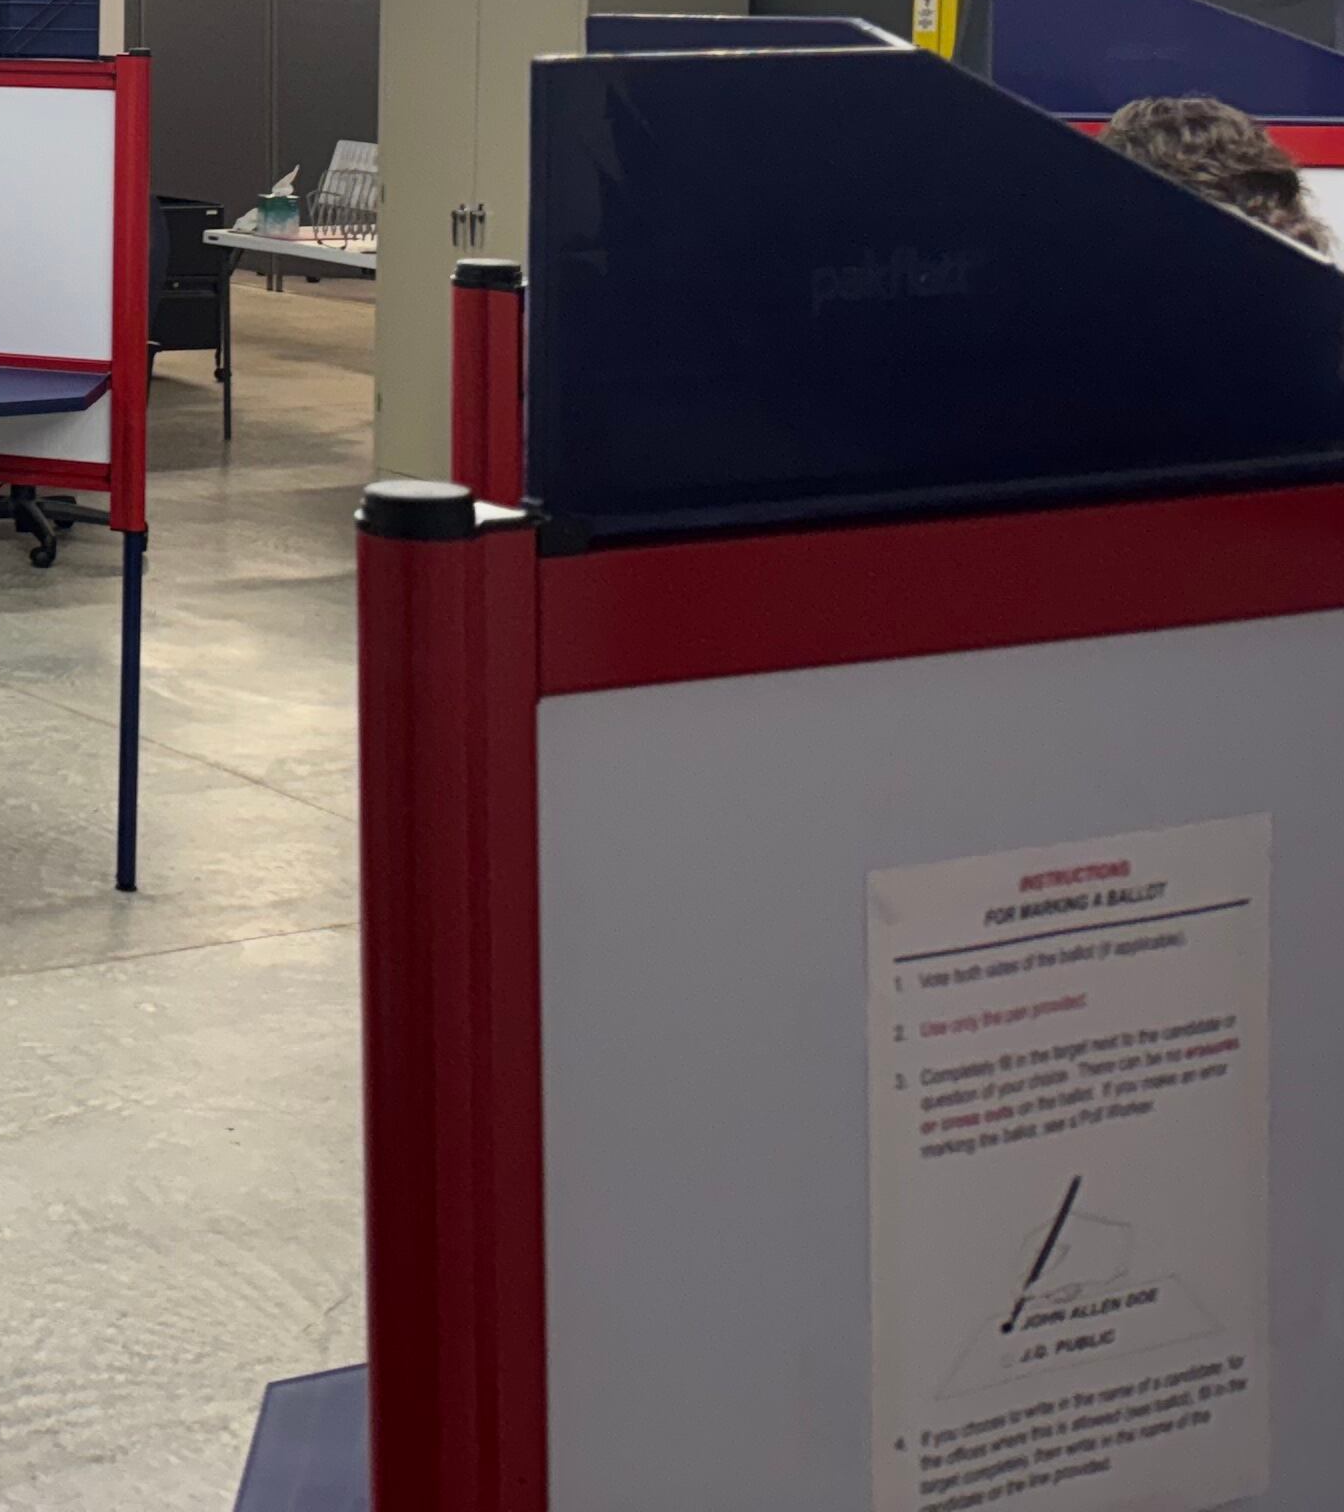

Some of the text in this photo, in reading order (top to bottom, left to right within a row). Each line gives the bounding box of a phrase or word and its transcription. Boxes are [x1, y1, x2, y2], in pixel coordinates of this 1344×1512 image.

[984, 905, 1016, 925] FOR
[1019, 894, 1088, 919] MARKING
[1106, 881, 1166, 907] BALLOT
[1021, 1309, 1066, 1330] JOHN
[1069, 1297, 1122, 1319] ALLEN
[1055, 1329, 1114, 1353] PUBLIC
